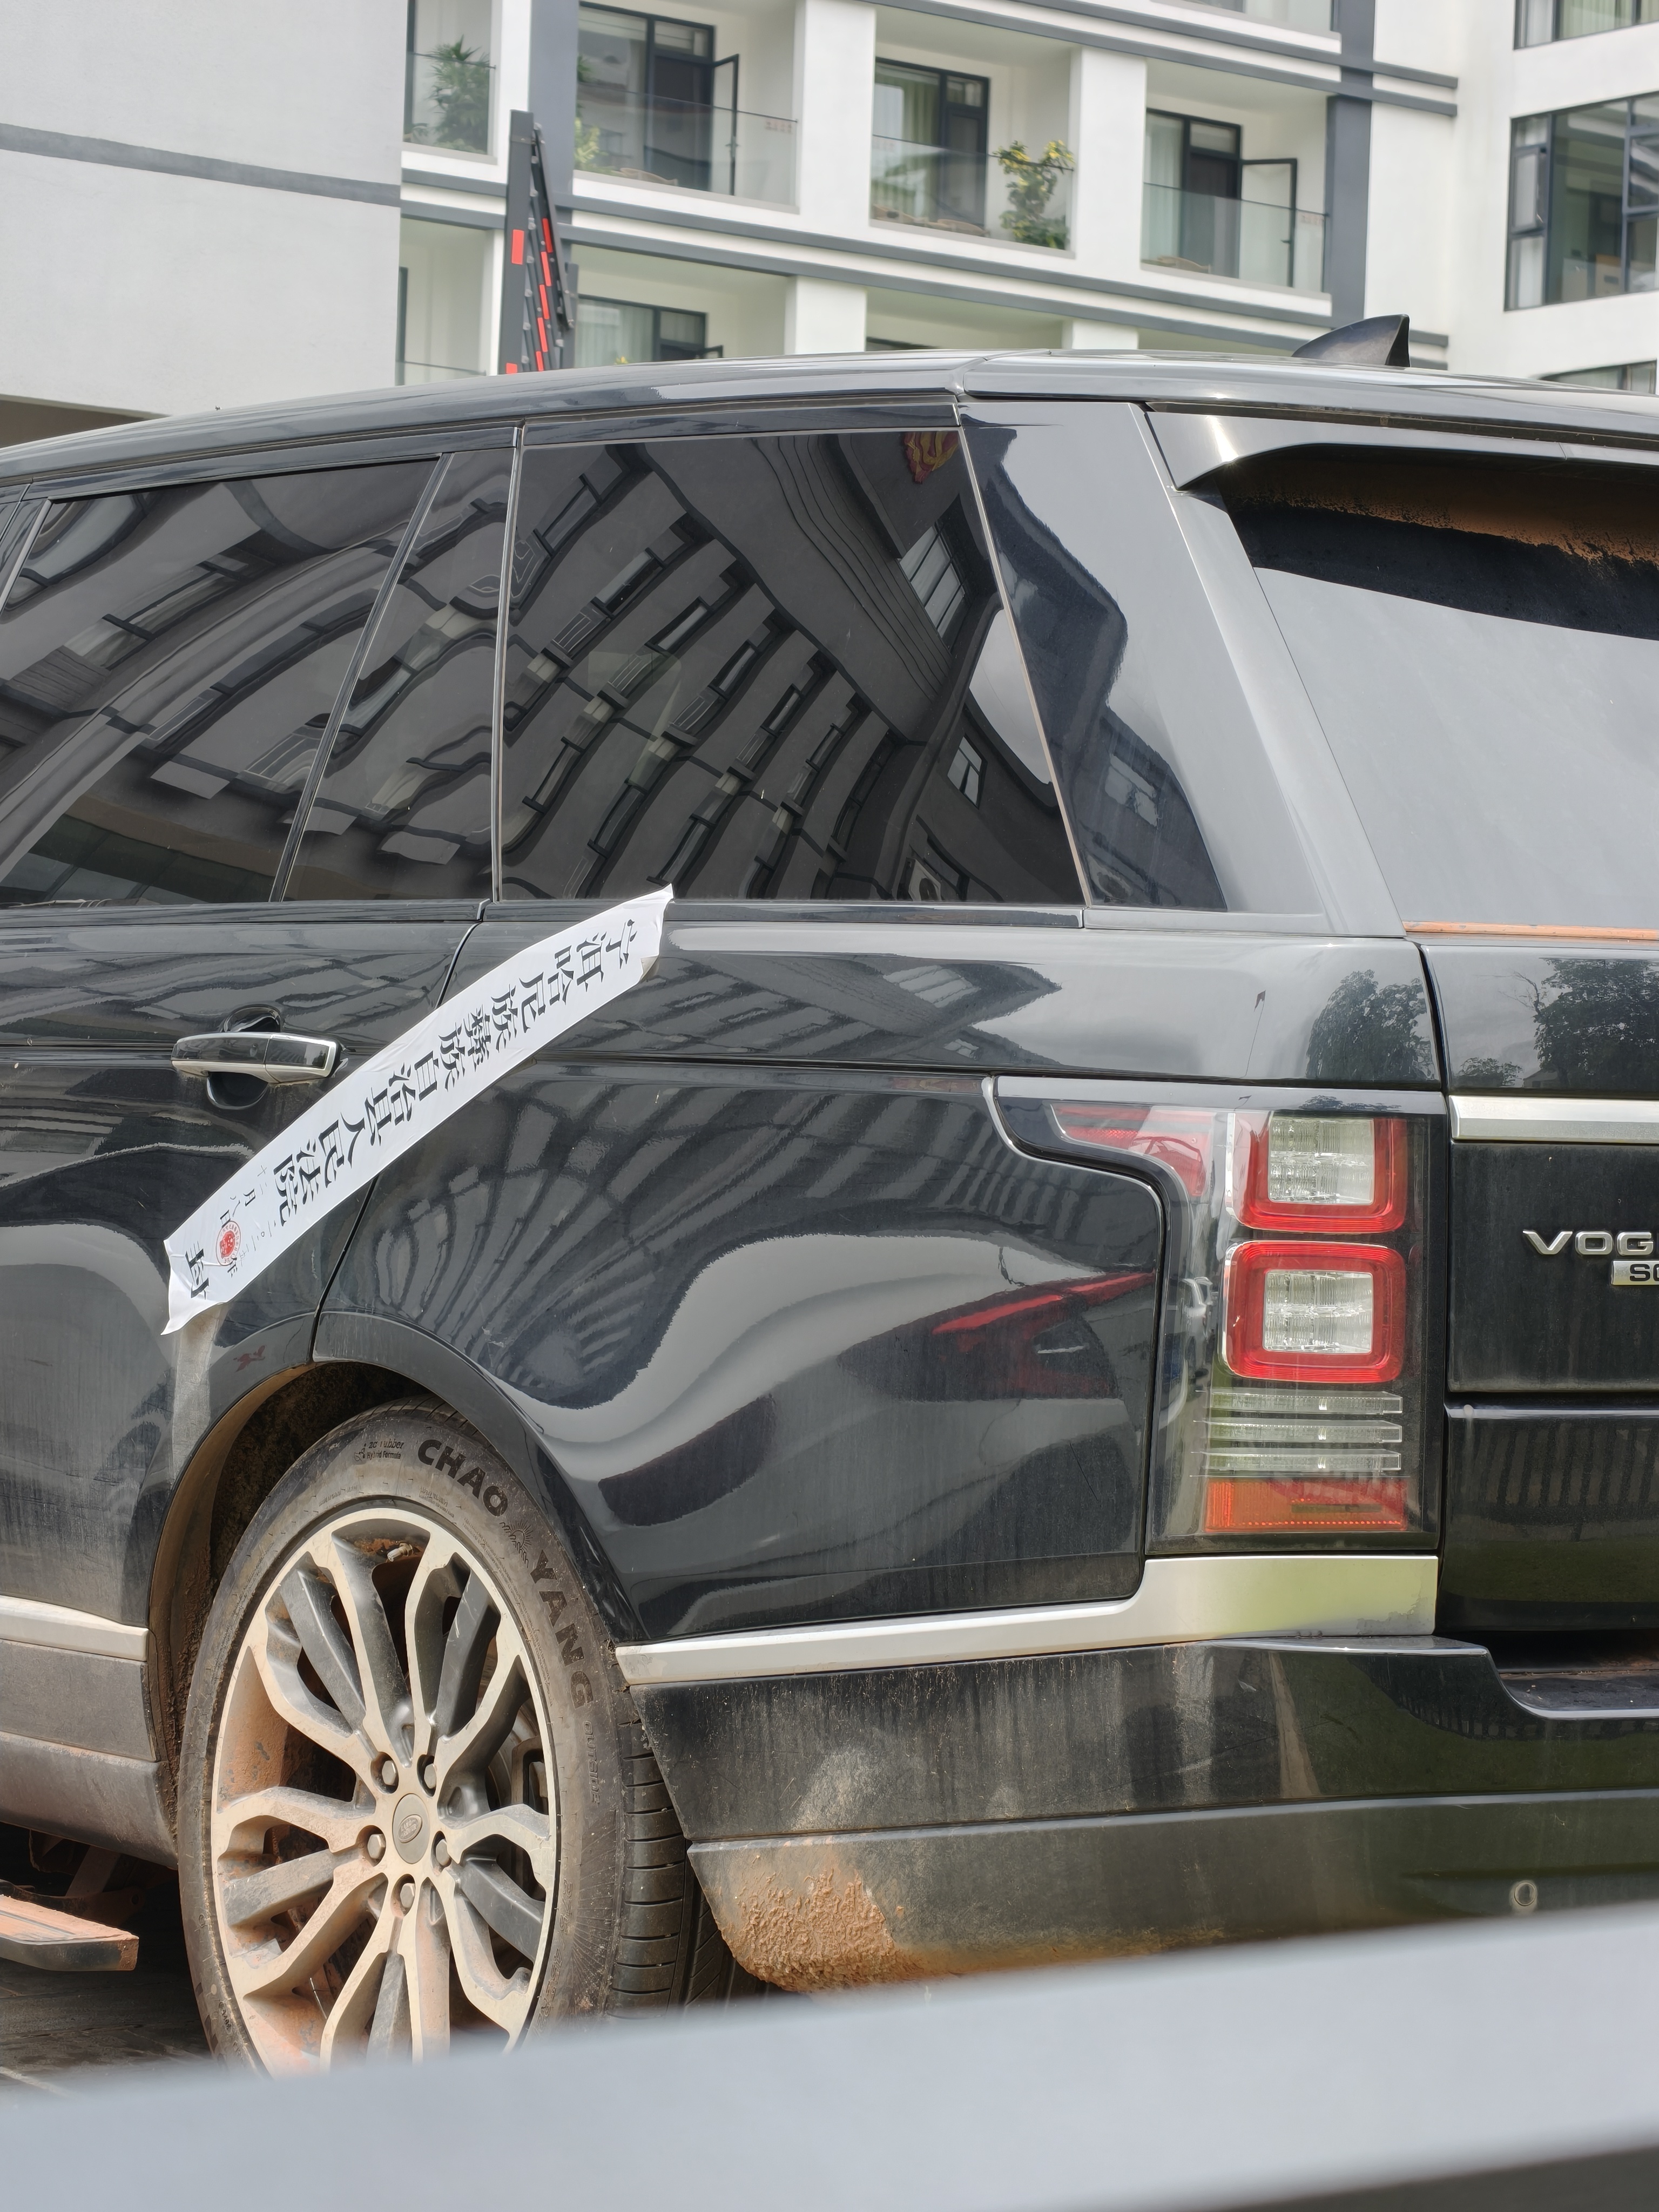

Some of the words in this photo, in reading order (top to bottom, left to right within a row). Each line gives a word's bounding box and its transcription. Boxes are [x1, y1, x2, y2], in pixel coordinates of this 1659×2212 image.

[273, 919, 637, 1226] 宁洱哈尼族彝族自治县人民法院
[220, 1165, 267, 1228] 十二月八日
[186, 1240, 210, 1300] 封
[380, 1438, 404, 1449] rubber
[417, 1439, 508, 1517] CHAO
[530, 1549, 594, 1709] YANG
[583, 1720, 600, 1804] OUTSIDE
